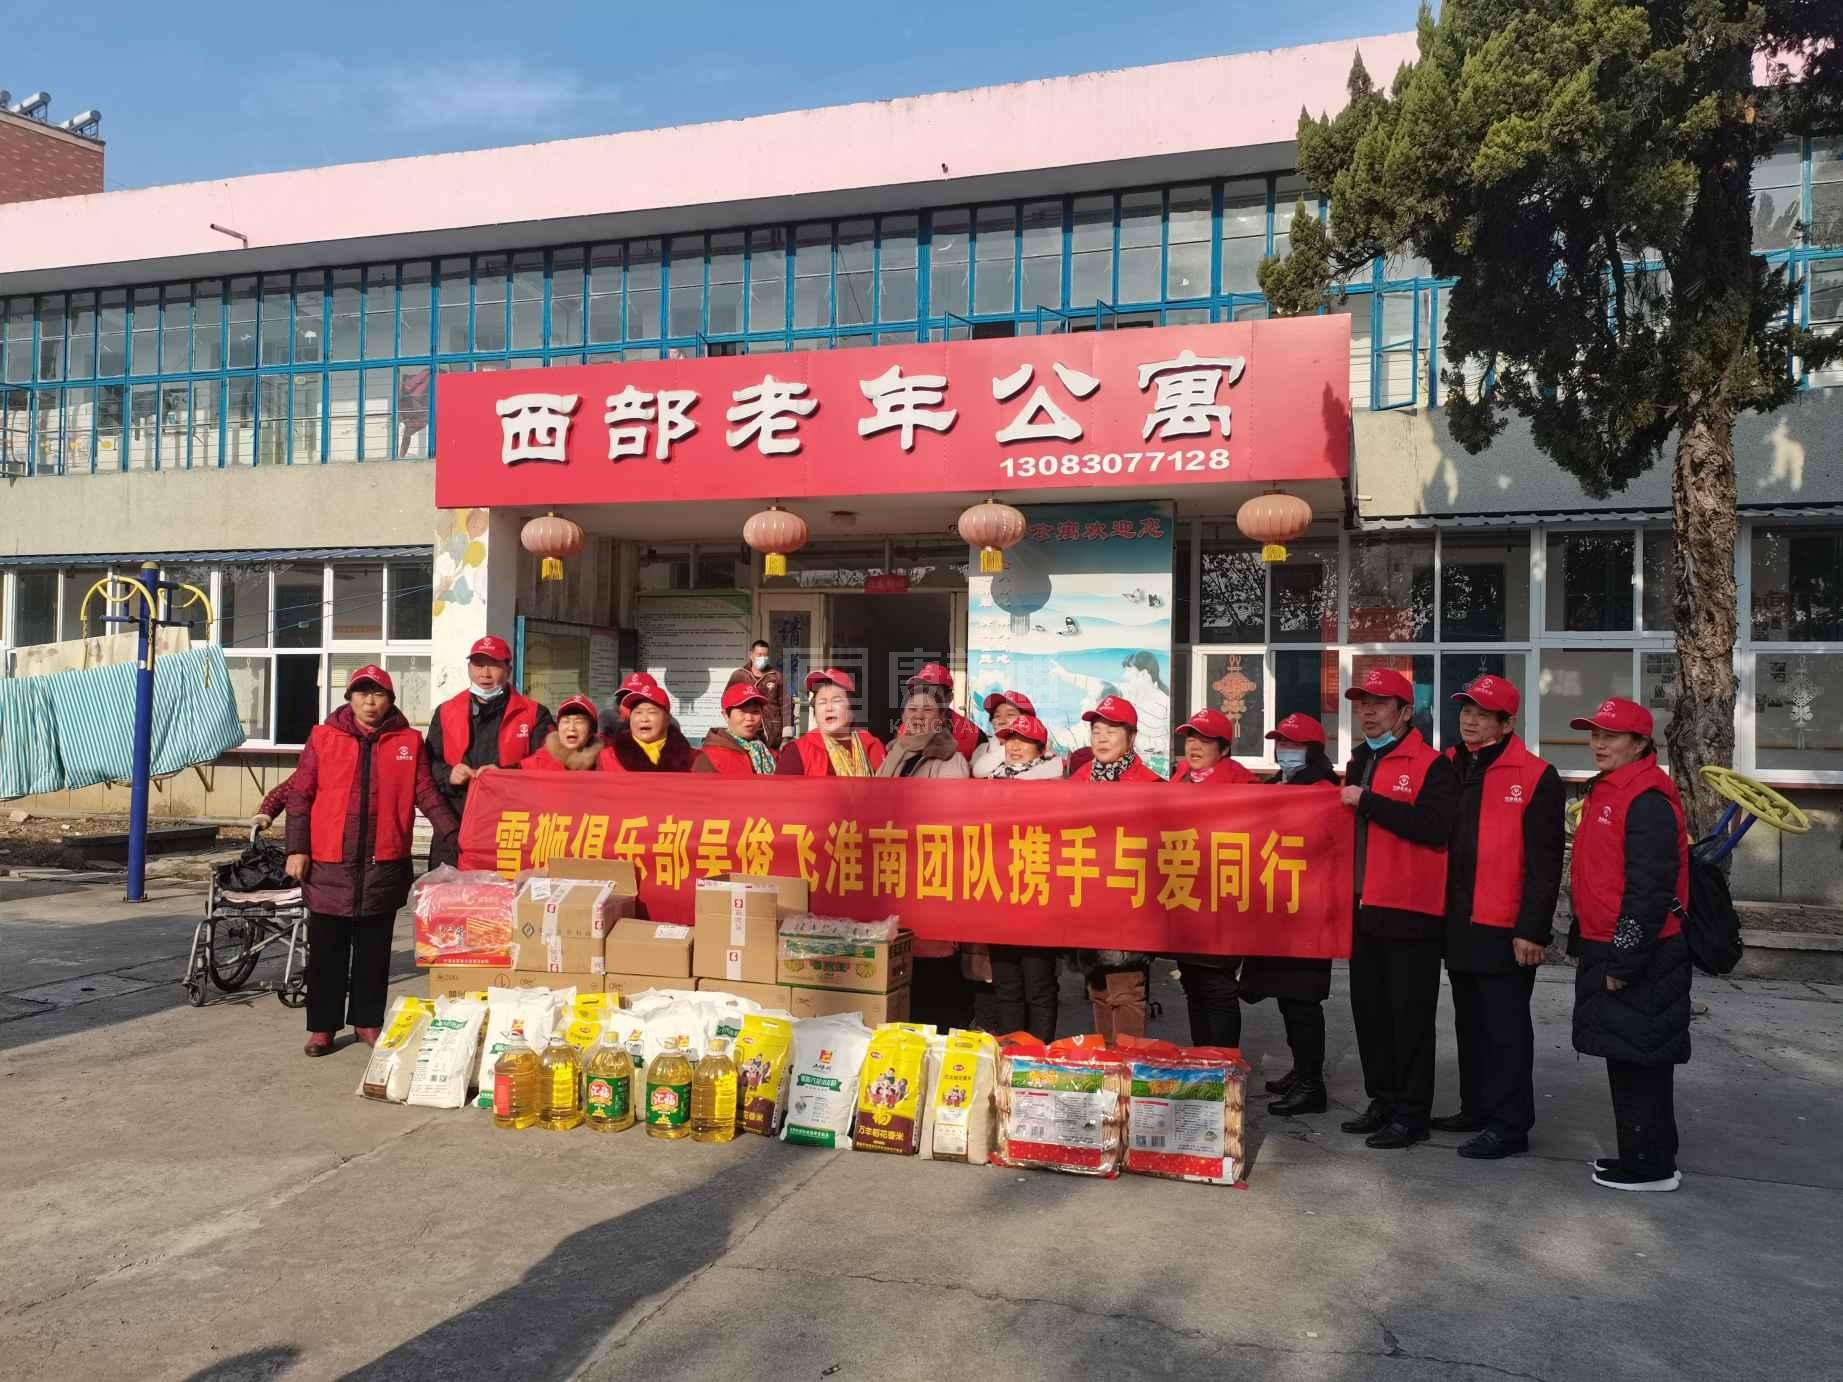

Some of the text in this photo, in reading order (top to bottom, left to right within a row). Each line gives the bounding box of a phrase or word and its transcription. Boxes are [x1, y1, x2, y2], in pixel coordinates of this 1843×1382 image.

[495, 349, 1246, 466] 西部老年公寓
[999, 448, 1231, 478] 13083077128
[1026, 516, 1165, 543] 公寓欢迎您
[495, 810, 1307, 915] 雪狮俱乐部吴俊飞淮南团队携手与爱同行
